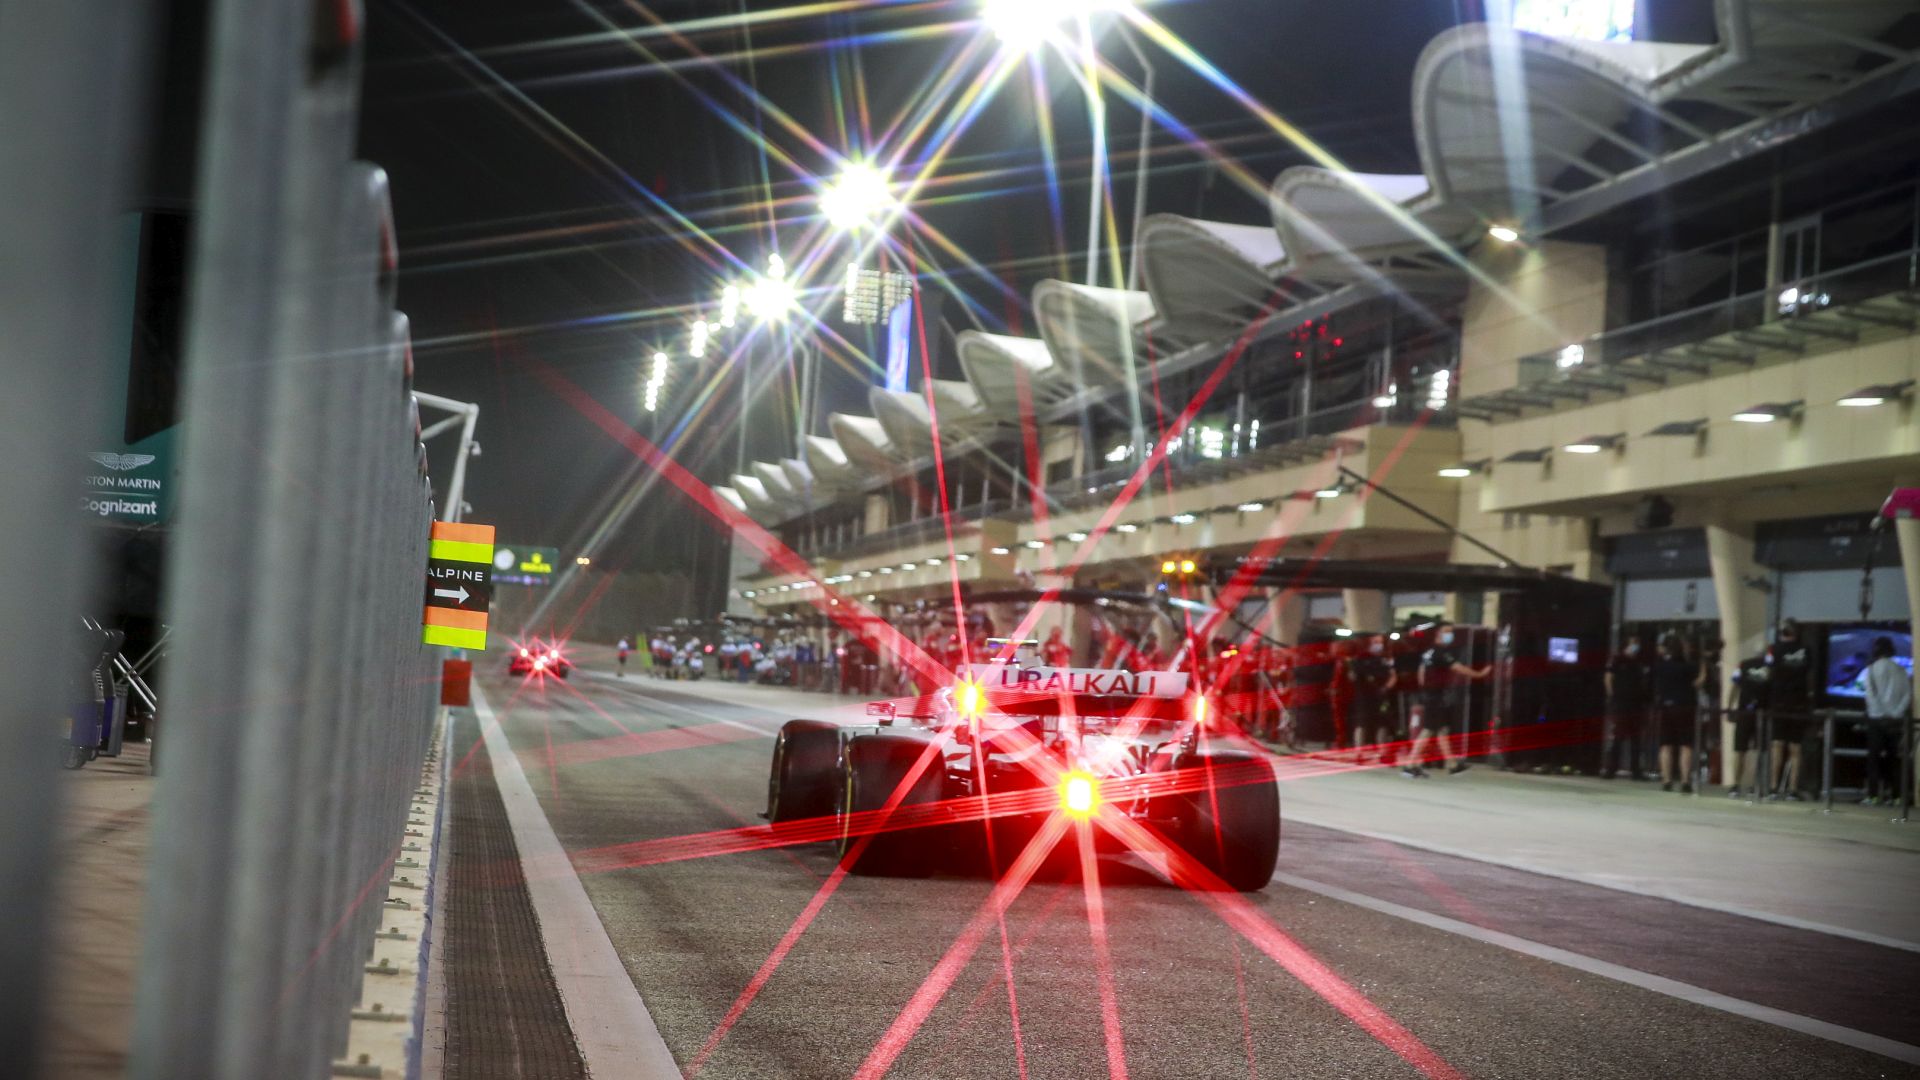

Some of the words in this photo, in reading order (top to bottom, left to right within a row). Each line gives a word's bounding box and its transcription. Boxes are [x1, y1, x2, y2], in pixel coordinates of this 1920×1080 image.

[85, 476, 115, 487] STON
[118, 479, 160, 489] MARTIN
[80, 498, 157, 516] Cognizant
[427, 567, 483, 581] ALPINE
[1001, 669, 1156, 696] URALKALI
